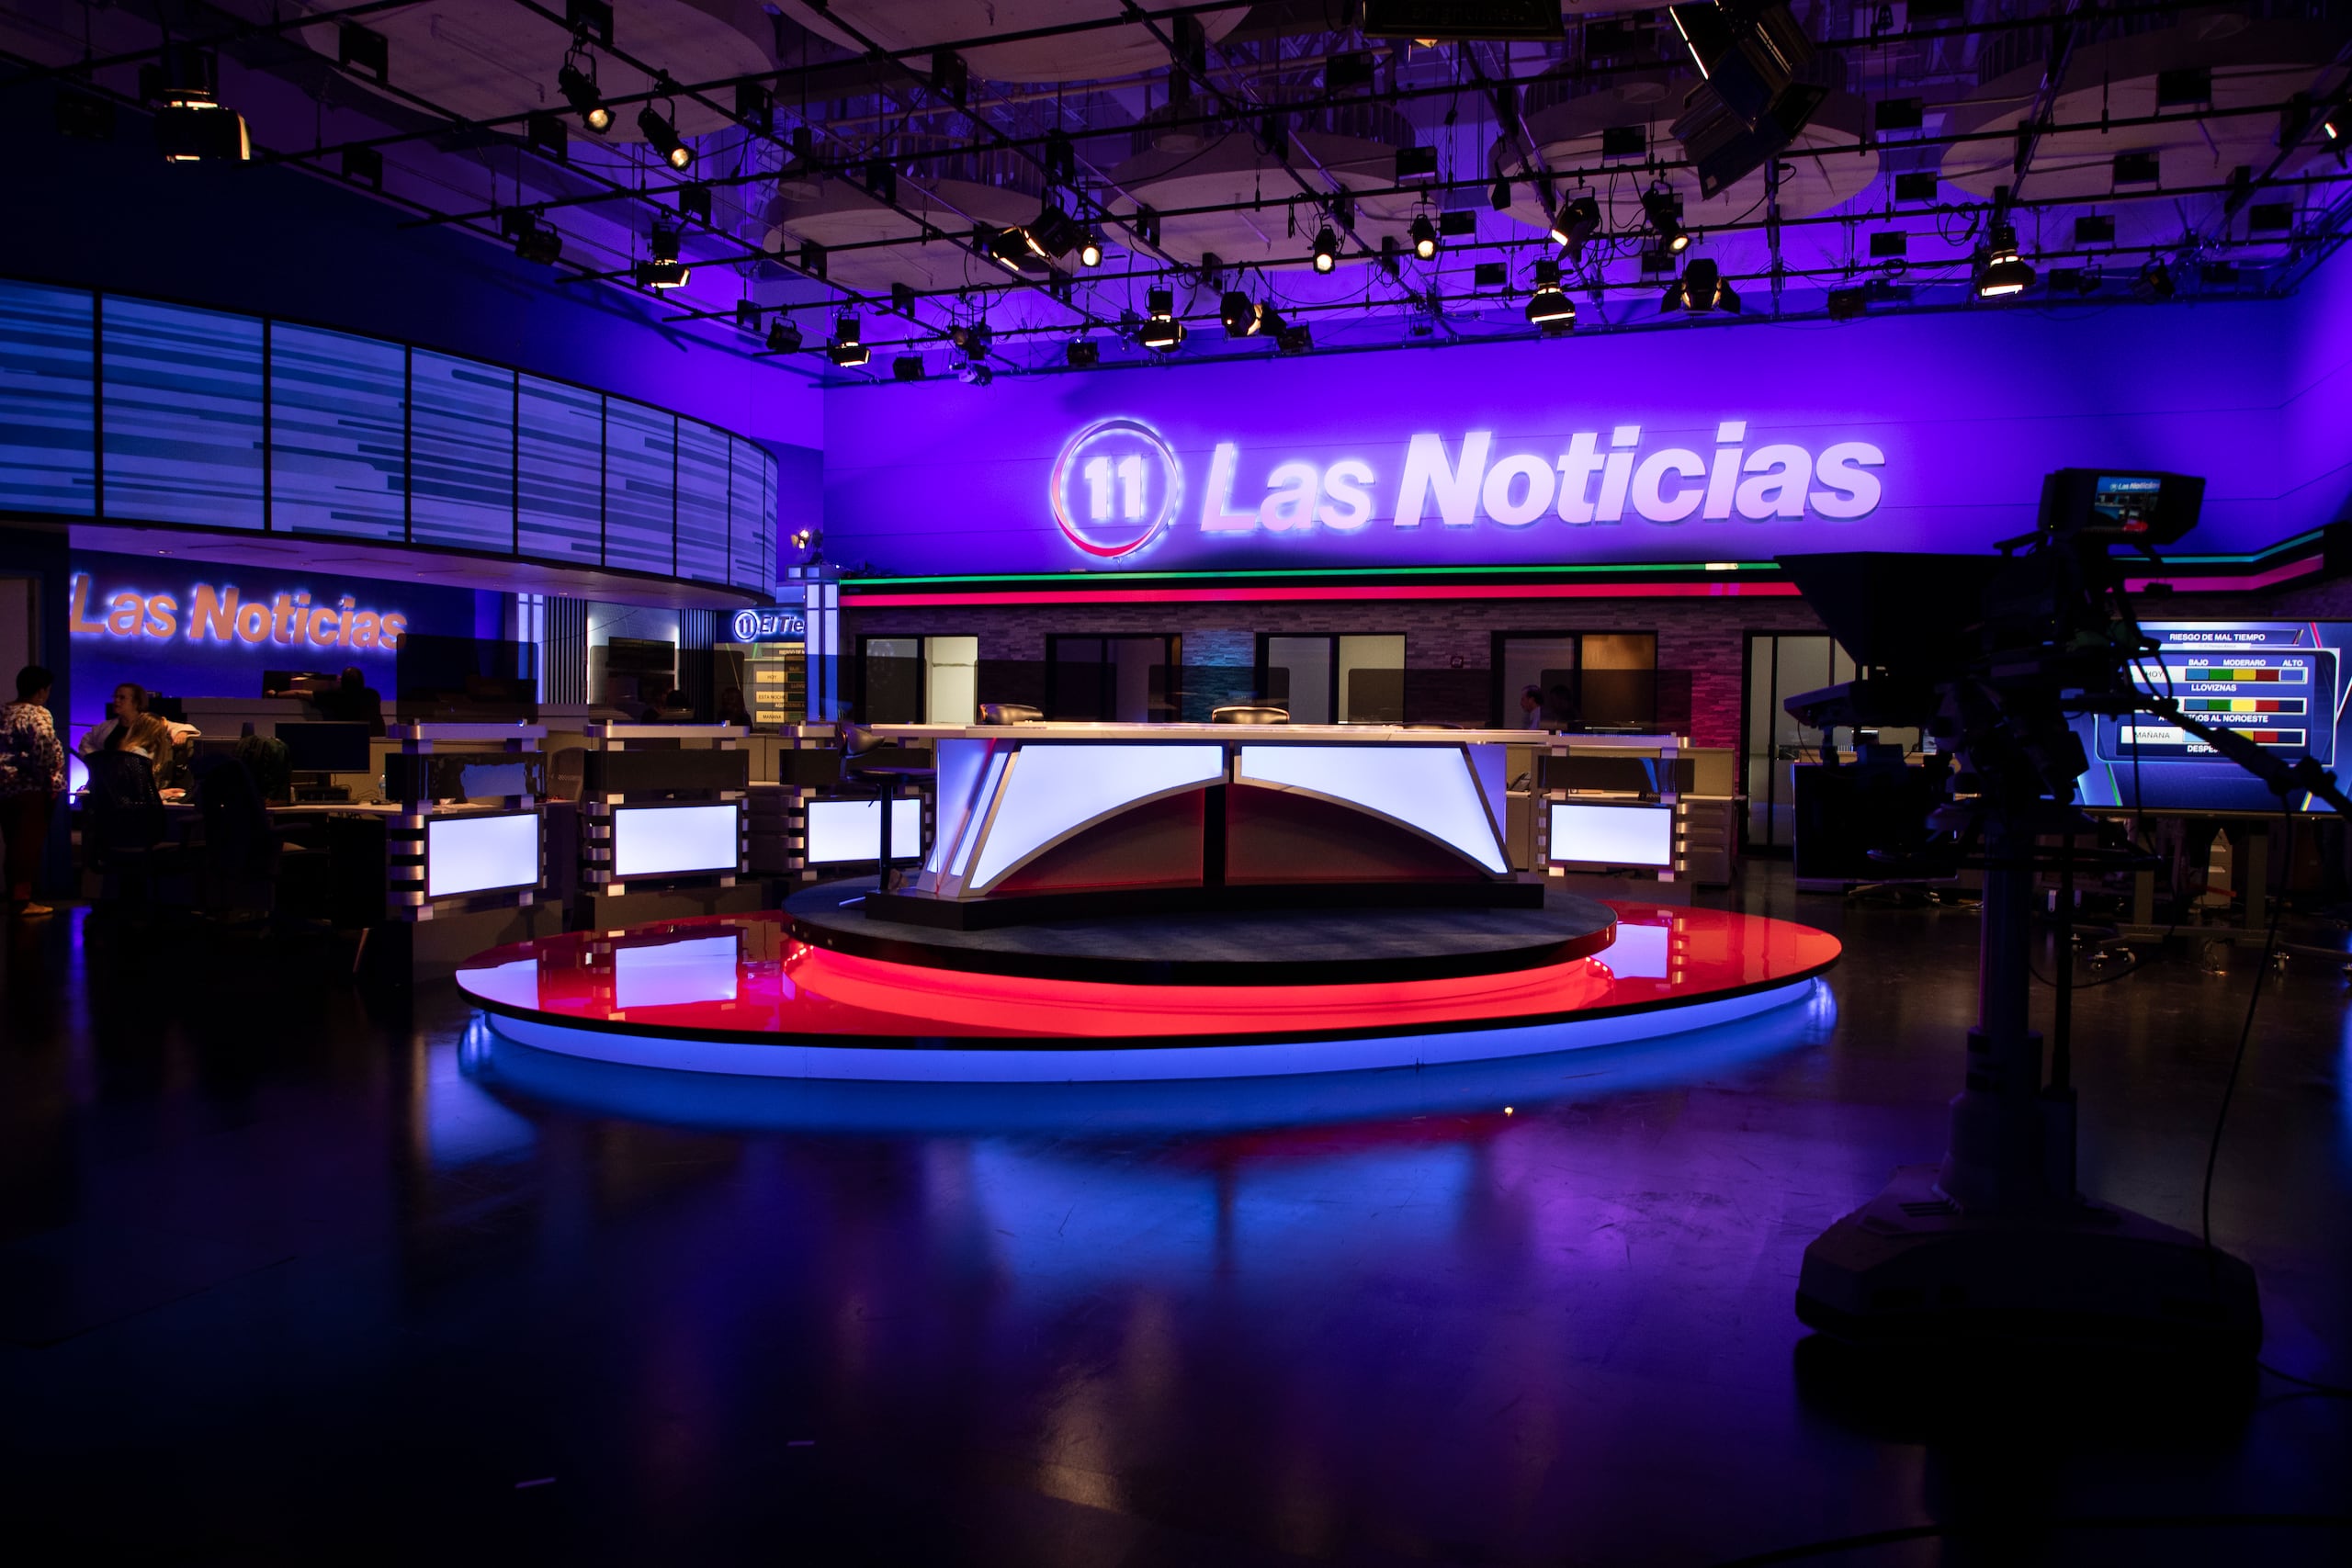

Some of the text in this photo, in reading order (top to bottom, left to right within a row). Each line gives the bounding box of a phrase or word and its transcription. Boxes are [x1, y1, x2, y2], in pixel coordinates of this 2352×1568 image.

[1084, 421, 1886, 531] 11 Las Noticias
[69, 574, 408, 650] Las Noticias
[739, 616, 805, 633] 11 El Tie
[2169, 633, 2266, 641] RIESGO DE MAL TIEMPO
[2190, 683, 2237, 692] LLOVIZNAS
[2222, 715, 2268, 723] NOROESTE
